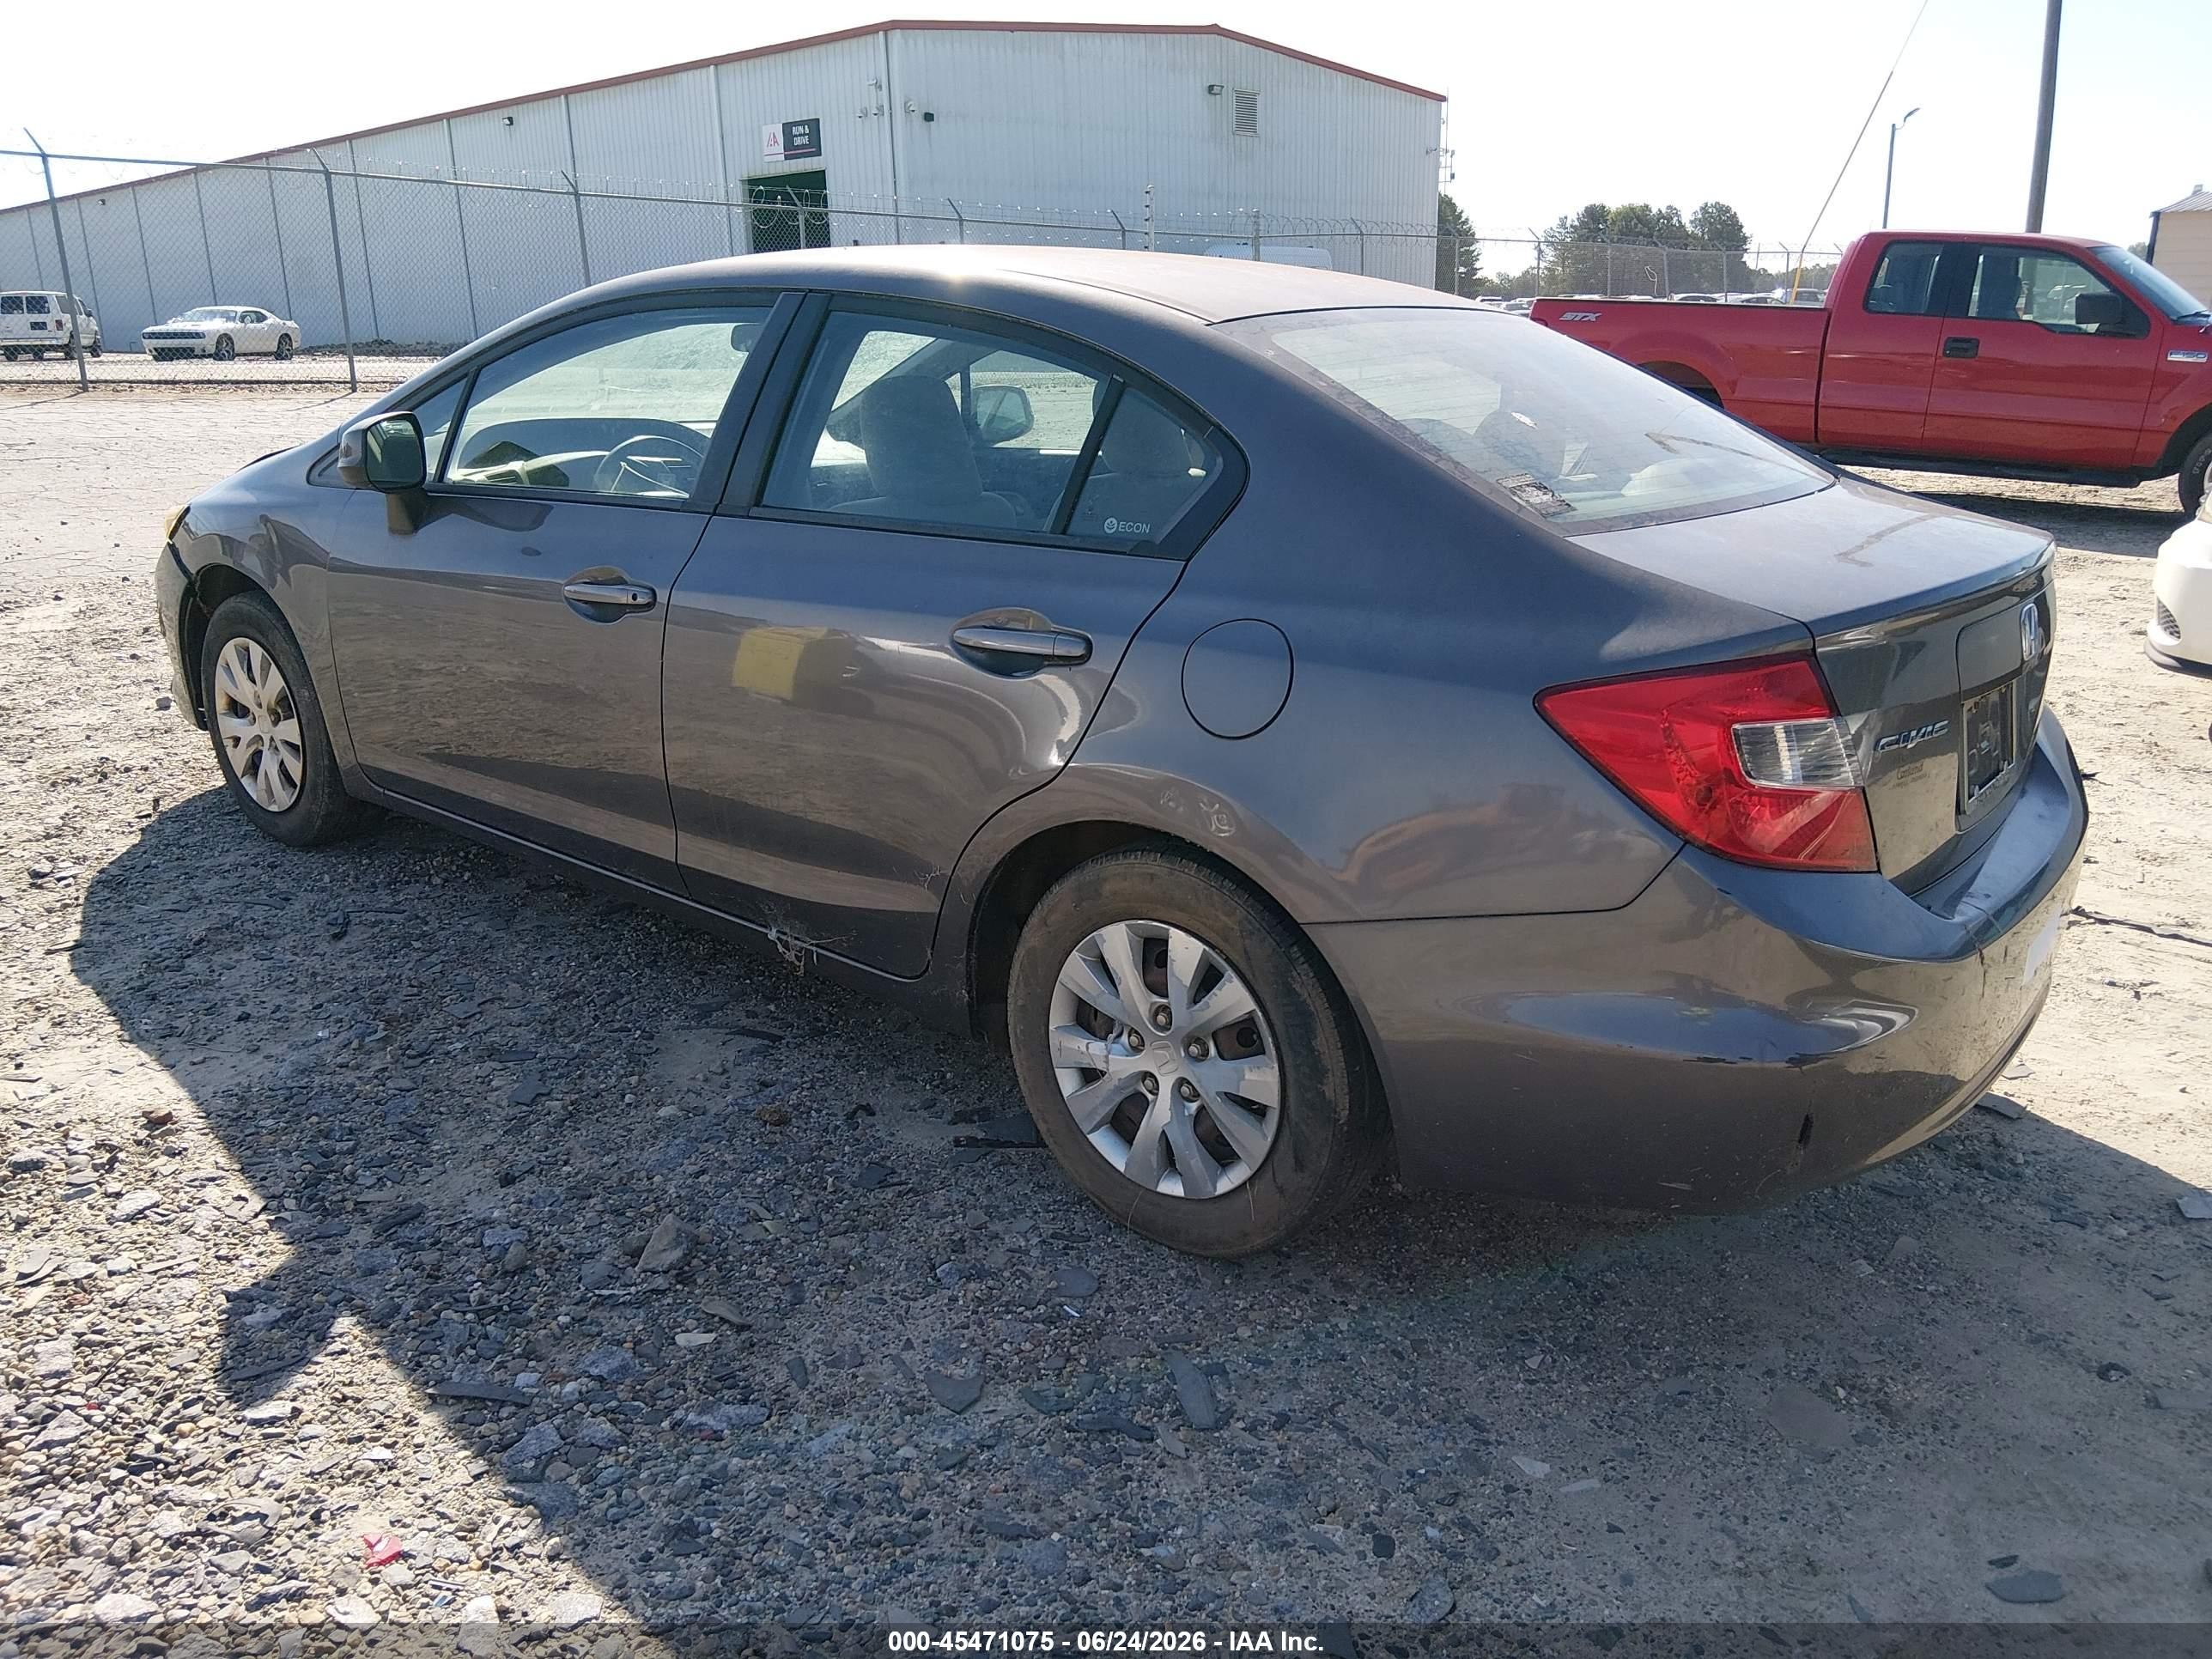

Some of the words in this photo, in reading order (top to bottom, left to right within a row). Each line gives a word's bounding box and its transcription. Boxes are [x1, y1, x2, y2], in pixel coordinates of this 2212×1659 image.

[792, 125, 804, 136] RUN
[805, 125, 809, 134] &
[793, 136, 810, 145] DRIVE
[1559, 312, 1602, 322] STX
[1118, 521, 1151, 534] ECON
[1875, 720, 1949, 752] CIVIC
